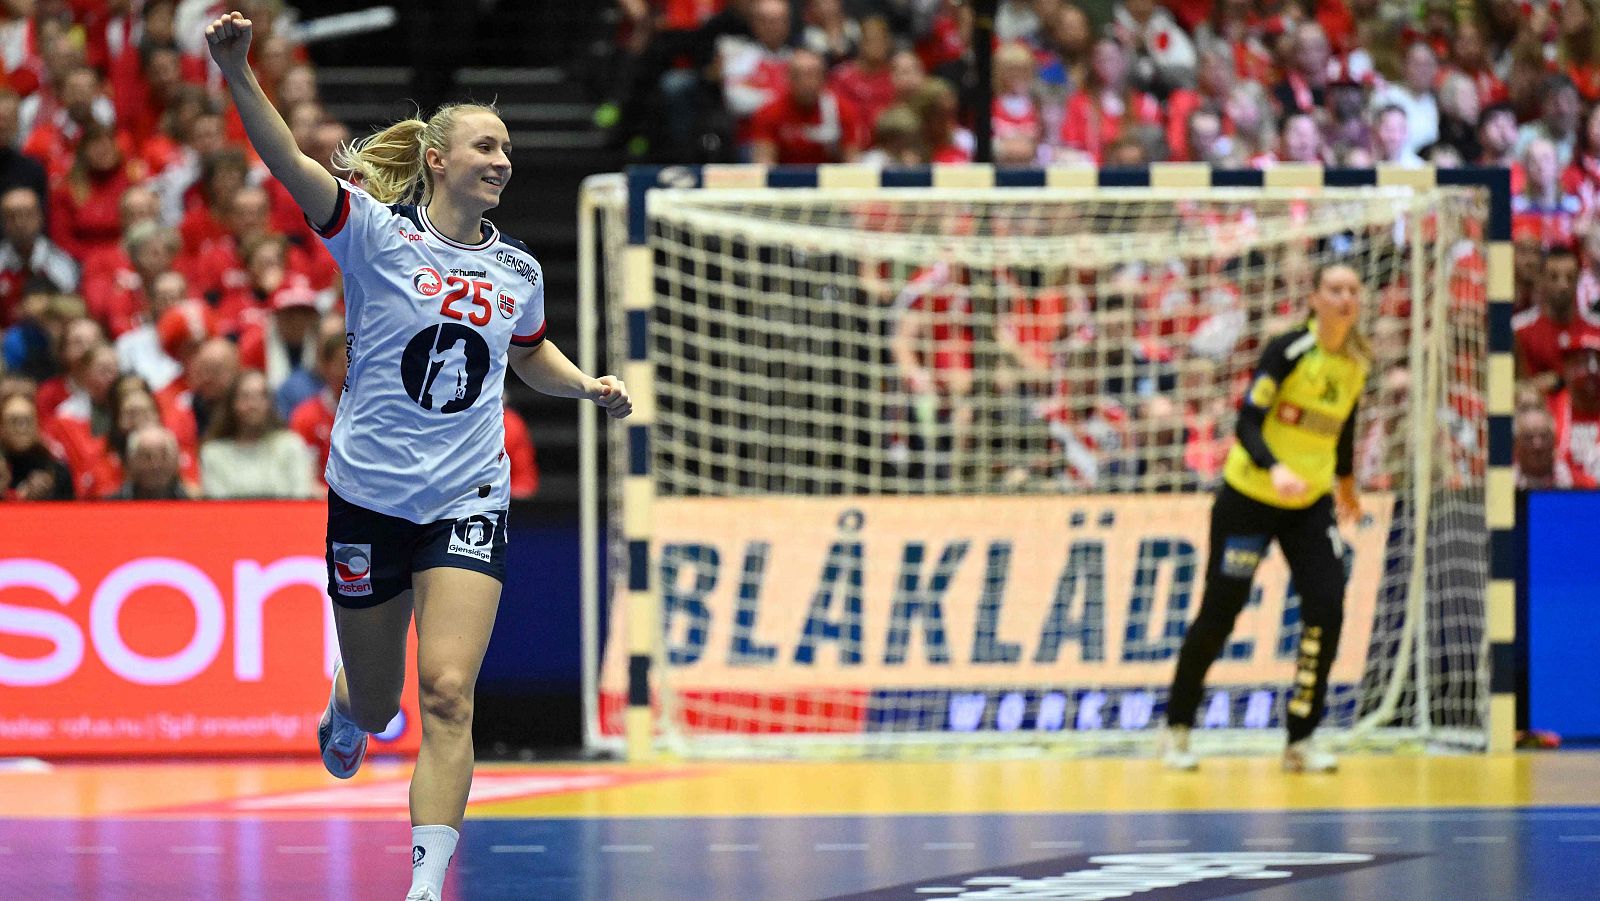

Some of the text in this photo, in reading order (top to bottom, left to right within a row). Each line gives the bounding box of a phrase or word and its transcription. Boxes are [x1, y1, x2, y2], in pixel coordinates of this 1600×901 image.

[459, 269, 487, 279] hummel
[496, 250, 539, 286] GJENSIDIGE
[440, 275, 493, 327] 25
[449, 544, 490, 560] Gjensidige
[660, 508, 1354, 666] BLÅKLÄD
